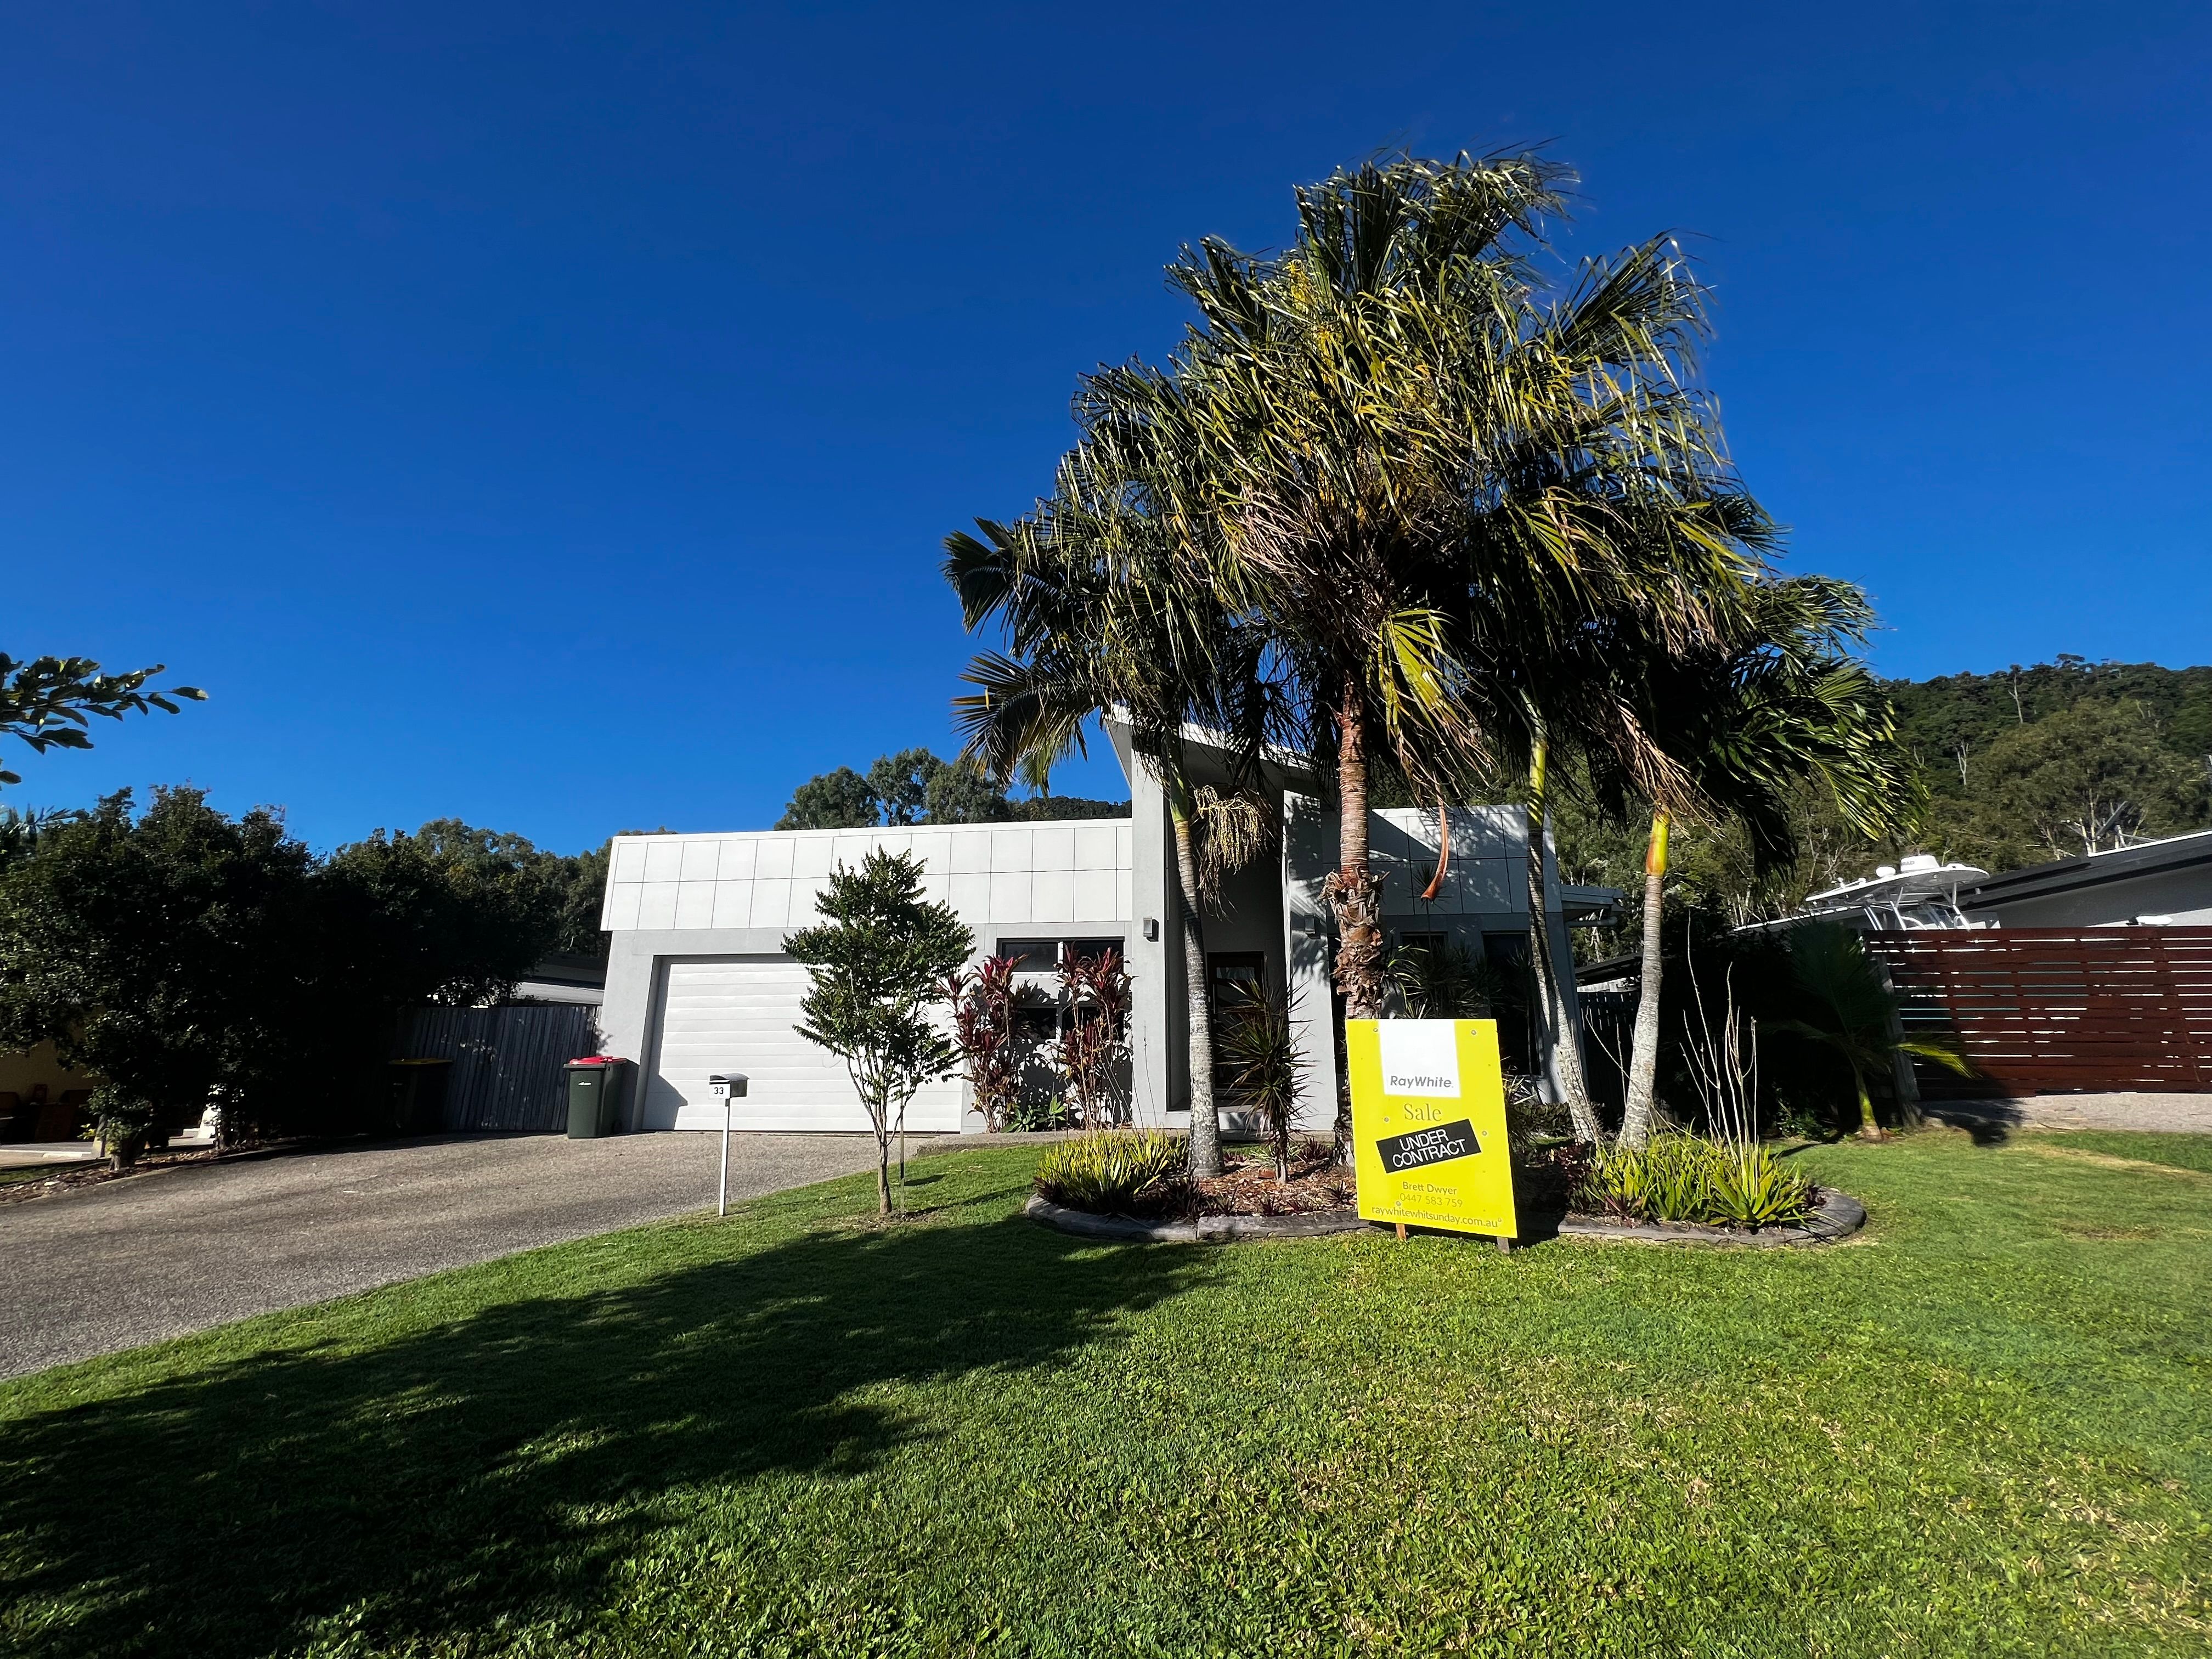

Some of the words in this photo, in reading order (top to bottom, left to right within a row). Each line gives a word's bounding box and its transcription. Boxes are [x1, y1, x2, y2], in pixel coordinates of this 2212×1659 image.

[1404, 1103, 1442, 1121] Sale
[1400, 1128, 1449, 1151] UNDER
[1392, 1139, 1465, 1167] CONTRACT
[1403, 1181, 1425, 1192] Brett
[1427, 1184, 1457, 1195] Dwyer
[1400, 1193, 1422, 1203] 0447
[1425, 1195, 1442, 1206] 583
[1444, 1198, 1463, 1207] 759
[1372, 1206, 1498, 1228] raywhitewhitsunday.com.au
